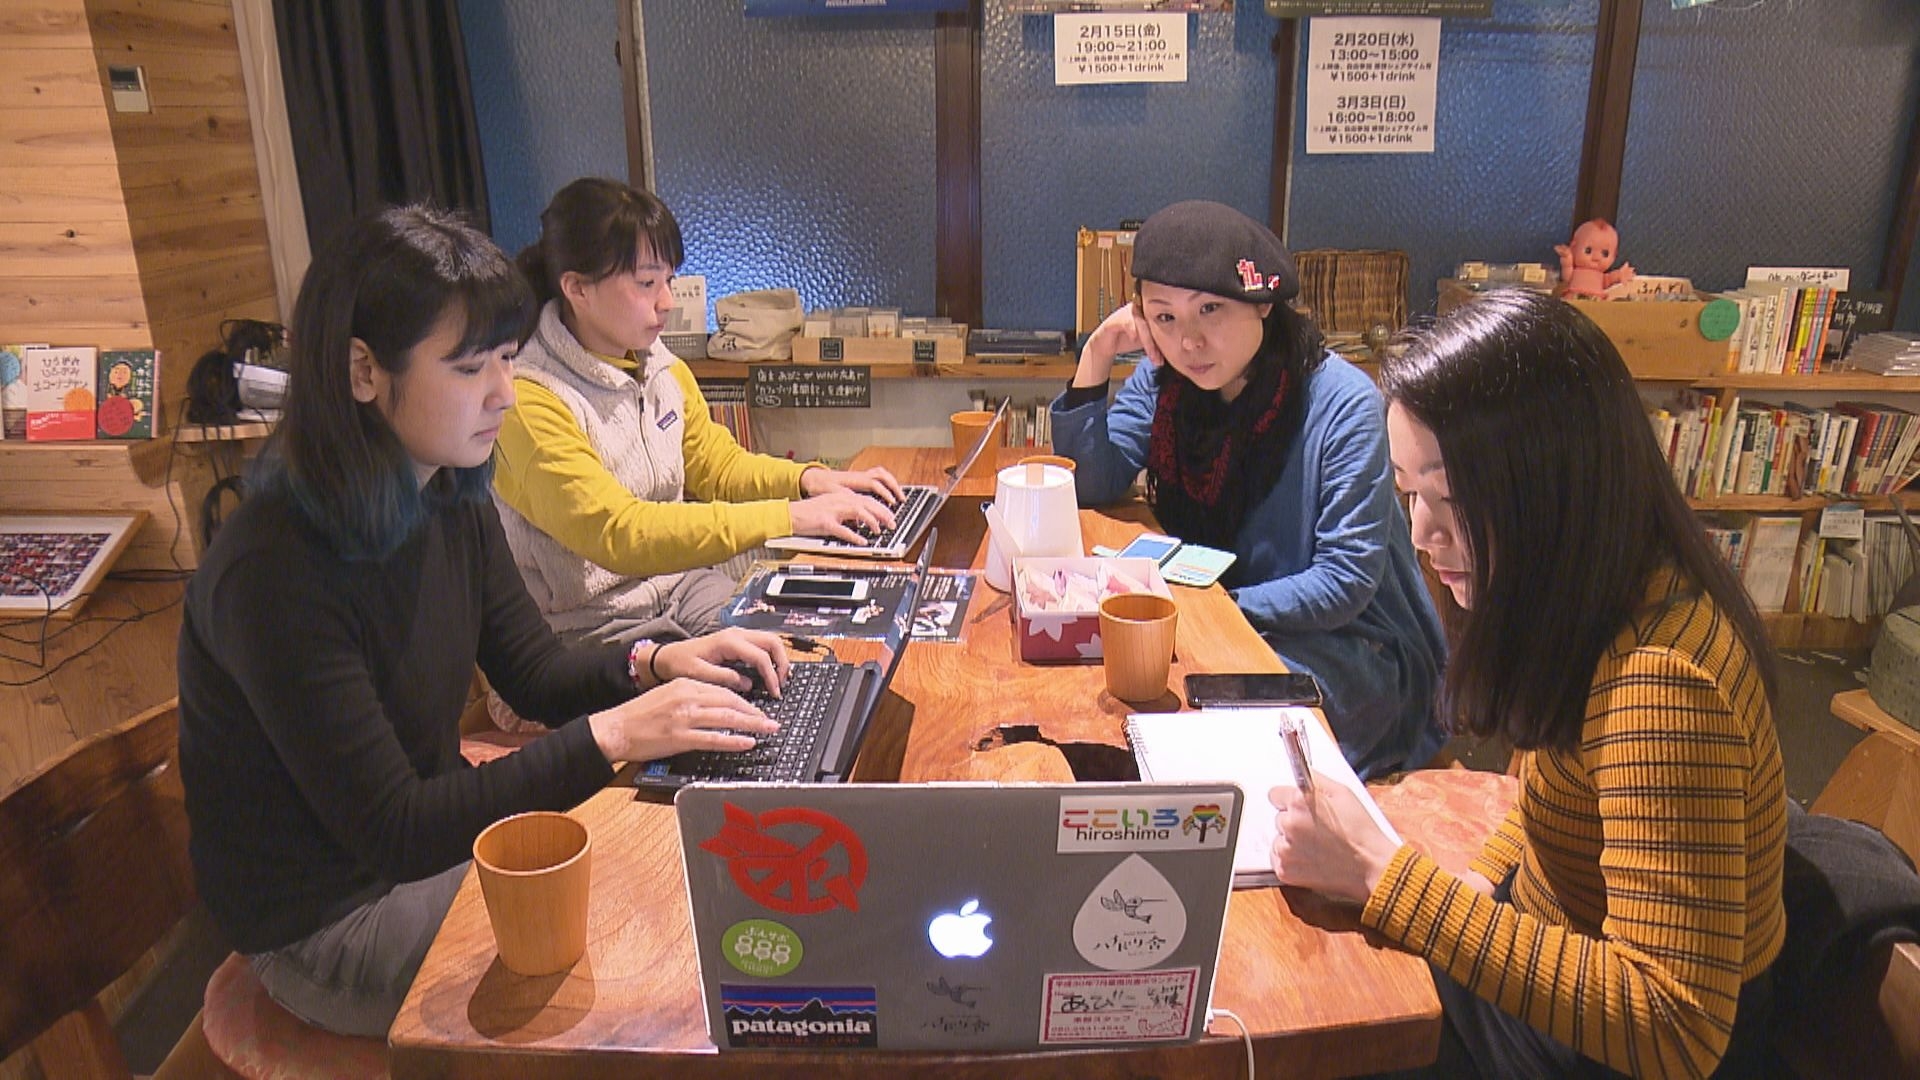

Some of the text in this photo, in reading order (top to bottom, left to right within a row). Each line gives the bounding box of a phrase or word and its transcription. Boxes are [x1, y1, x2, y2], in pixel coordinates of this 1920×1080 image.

[1079, 23, 1161, 39] 2月15日(金)
[1334, 32, 1414, 47] 2月20日(水)
[1336, 95, 1407, 110] 3月3日(日)
[1062, 808, 1180, 829] ここいろ
[1076, 825, 1170, 841] hiroshima
[1060, 988, 1139, 1014] あびこ
[731, 1018, 871, 1037] patagonia
